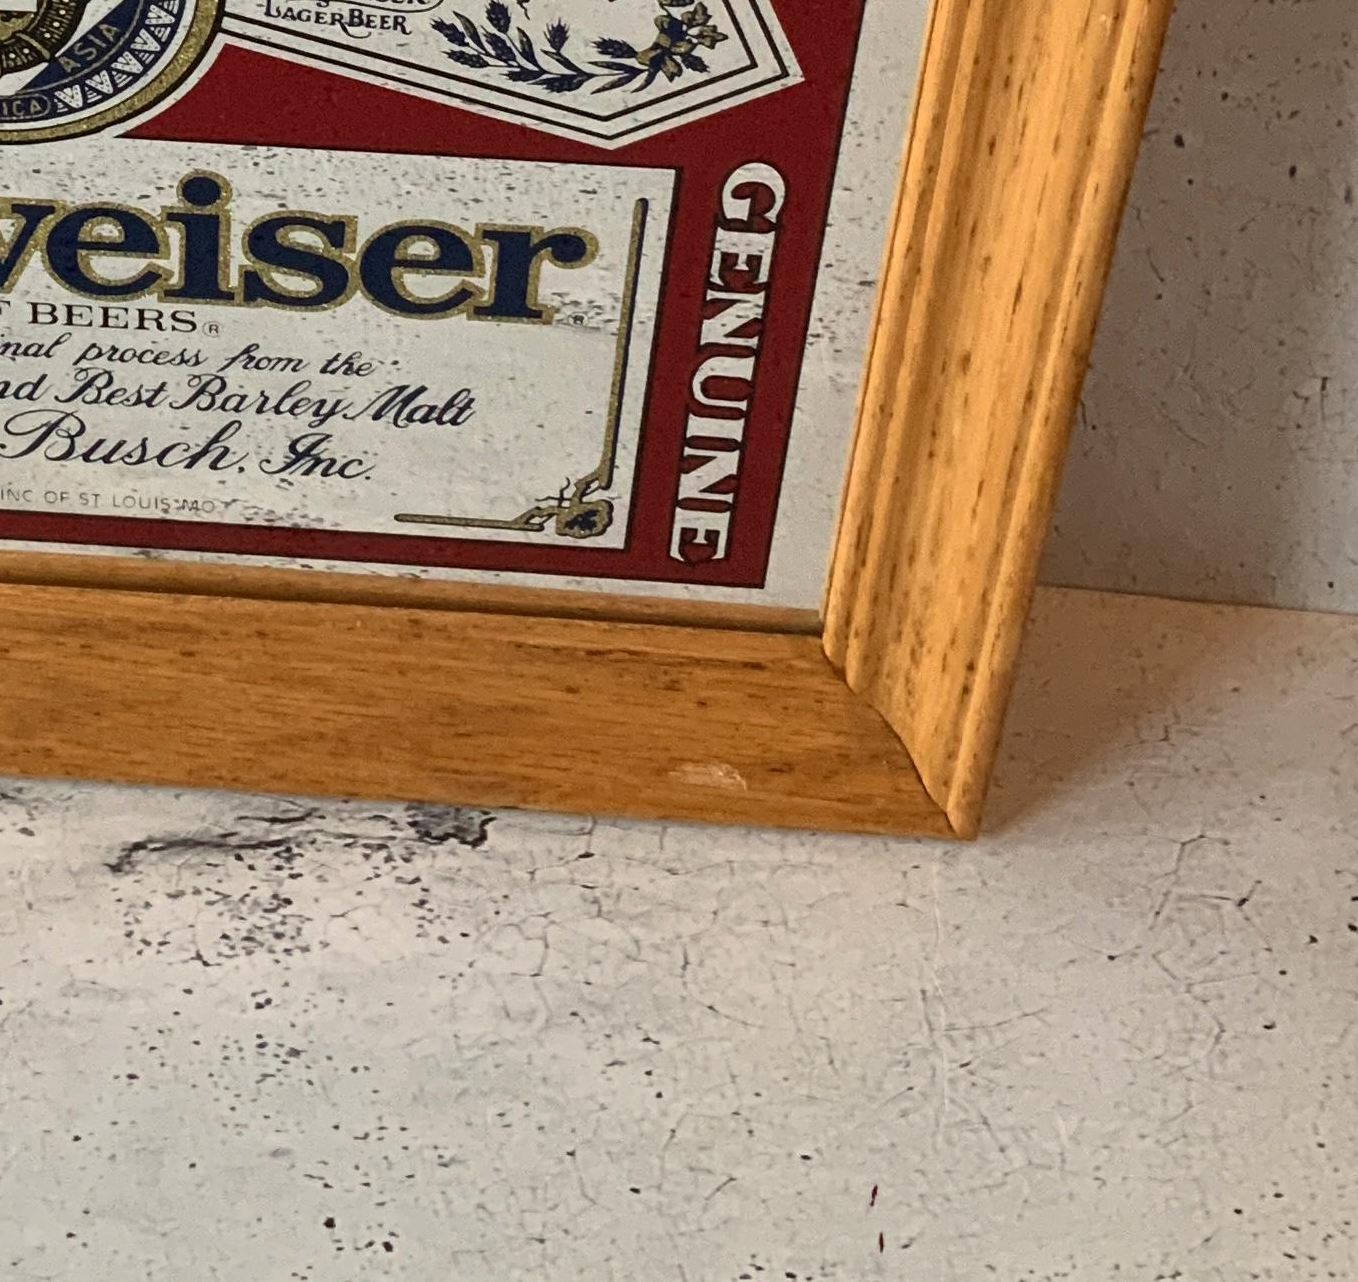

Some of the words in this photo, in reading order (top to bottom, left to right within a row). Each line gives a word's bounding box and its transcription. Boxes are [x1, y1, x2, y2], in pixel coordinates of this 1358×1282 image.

[348, 8, 412, 35] BEER
[58, 23, 121, 73] ASIA
[72, 343, 209, 367] process
[217, 343, 310, 373] from
[319, 350, 377, 377] the
[669, 162, 786, 562] GENUINE
[54, 367, 172, 408] Best
[169, 373, 354, 428] Barley
[343, 384, 477, 429] Malt
[259, 432, 376, 480] Inc.
[0, 487, 34, 503] INC
[43, 490, 70, 504] OF
[79, 492, 101, 507] ST
